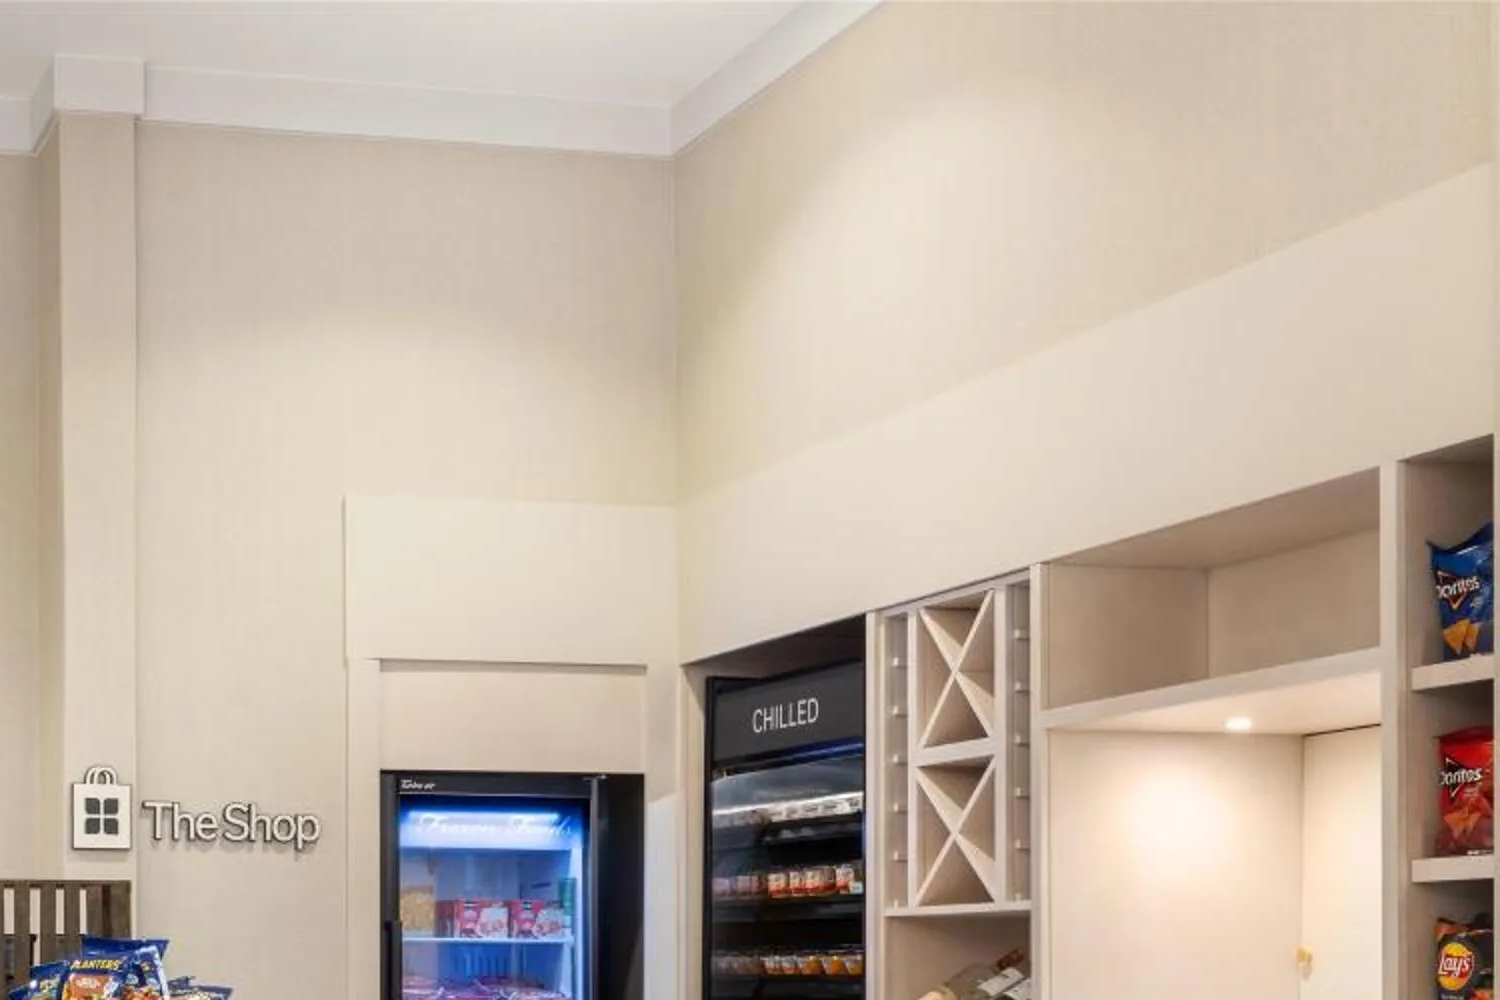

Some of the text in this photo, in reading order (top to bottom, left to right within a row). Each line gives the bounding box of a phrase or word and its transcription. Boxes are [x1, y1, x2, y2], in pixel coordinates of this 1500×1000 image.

[752, 697, 820, 734] CHILLED
[141, 800, 321, 852] The Shop
